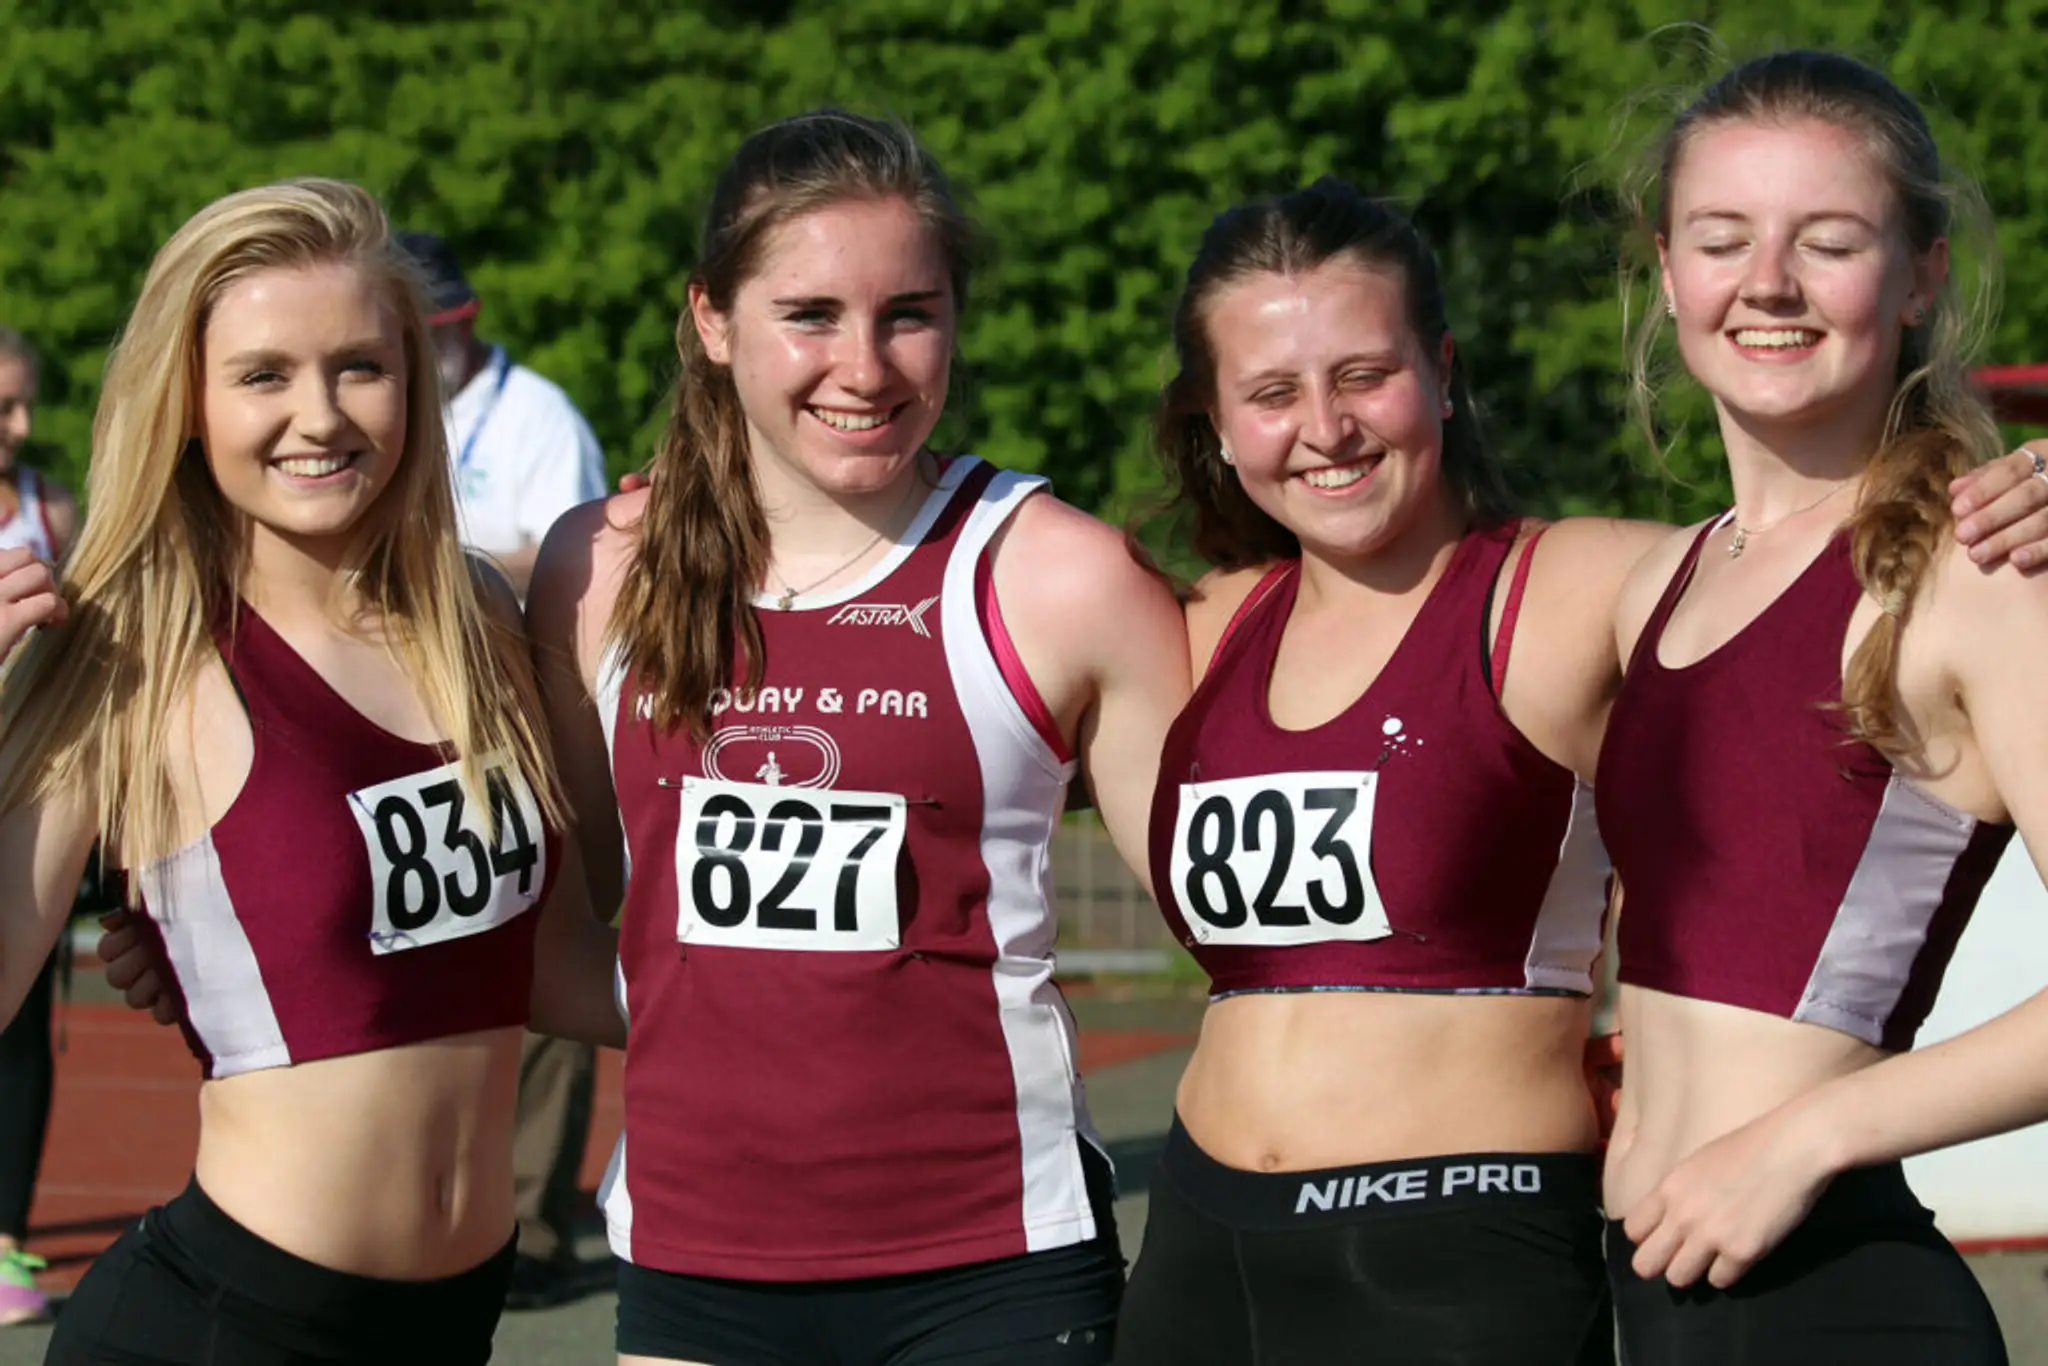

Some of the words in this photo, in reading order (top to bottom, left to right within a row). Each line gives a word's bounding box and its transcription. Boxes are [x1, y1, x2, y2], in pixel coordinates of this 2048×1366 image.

[826, 595, 940, 639] FASTRAX
[635, 686, 804, 720] NQUAY
[815, 687, 844, 714] &
[856, 687, 929, 719] PAR
[374, 765, 538, 931] 834
[691, 793, 892, 932] 827
[1185, 787, 1366, 930] 823
[1294, 1169, 1429, 1214] NIKE
[1441, 1163, 1542, 1197] PRO
